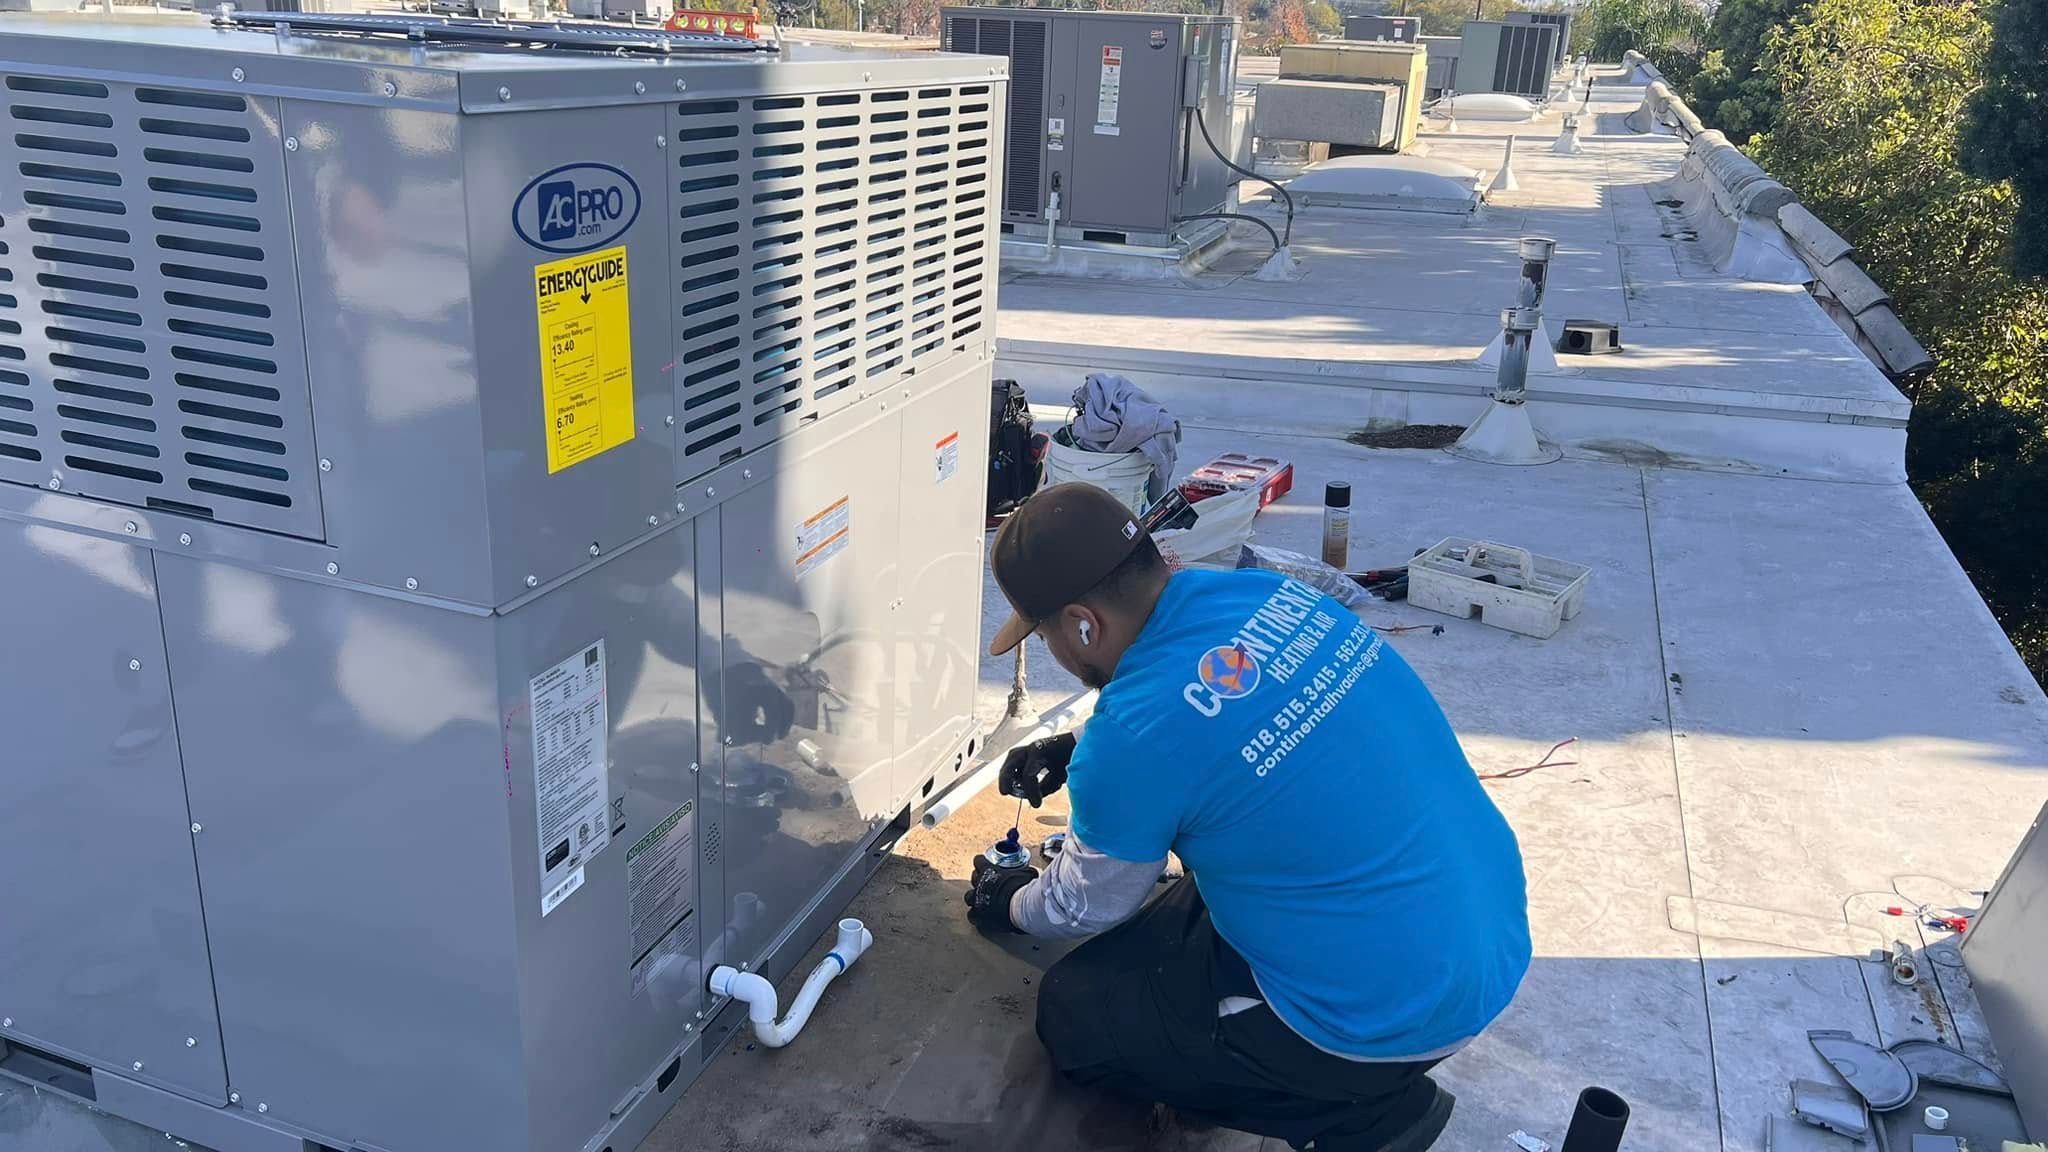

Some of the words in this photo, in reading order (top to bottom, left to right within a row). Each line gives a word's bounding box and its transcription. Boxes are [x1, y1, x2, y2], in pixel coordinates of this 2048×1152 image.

[578, 224, 601, 236] .com
[539, 258, 624, 297] ENERGYGUIDE
[552, 339, 575, 356] 13.40
[557, 412, 574, 429] 6.70
[1303, 625, 1326, 640] &
[1311, 610, 1338, 633] AIR
[1184, 578, 1325, 718] CONTINENTA
[1266, 632, 1319, 684] HEATING
[1241, 665, 1337, 763] 818.515.3415
